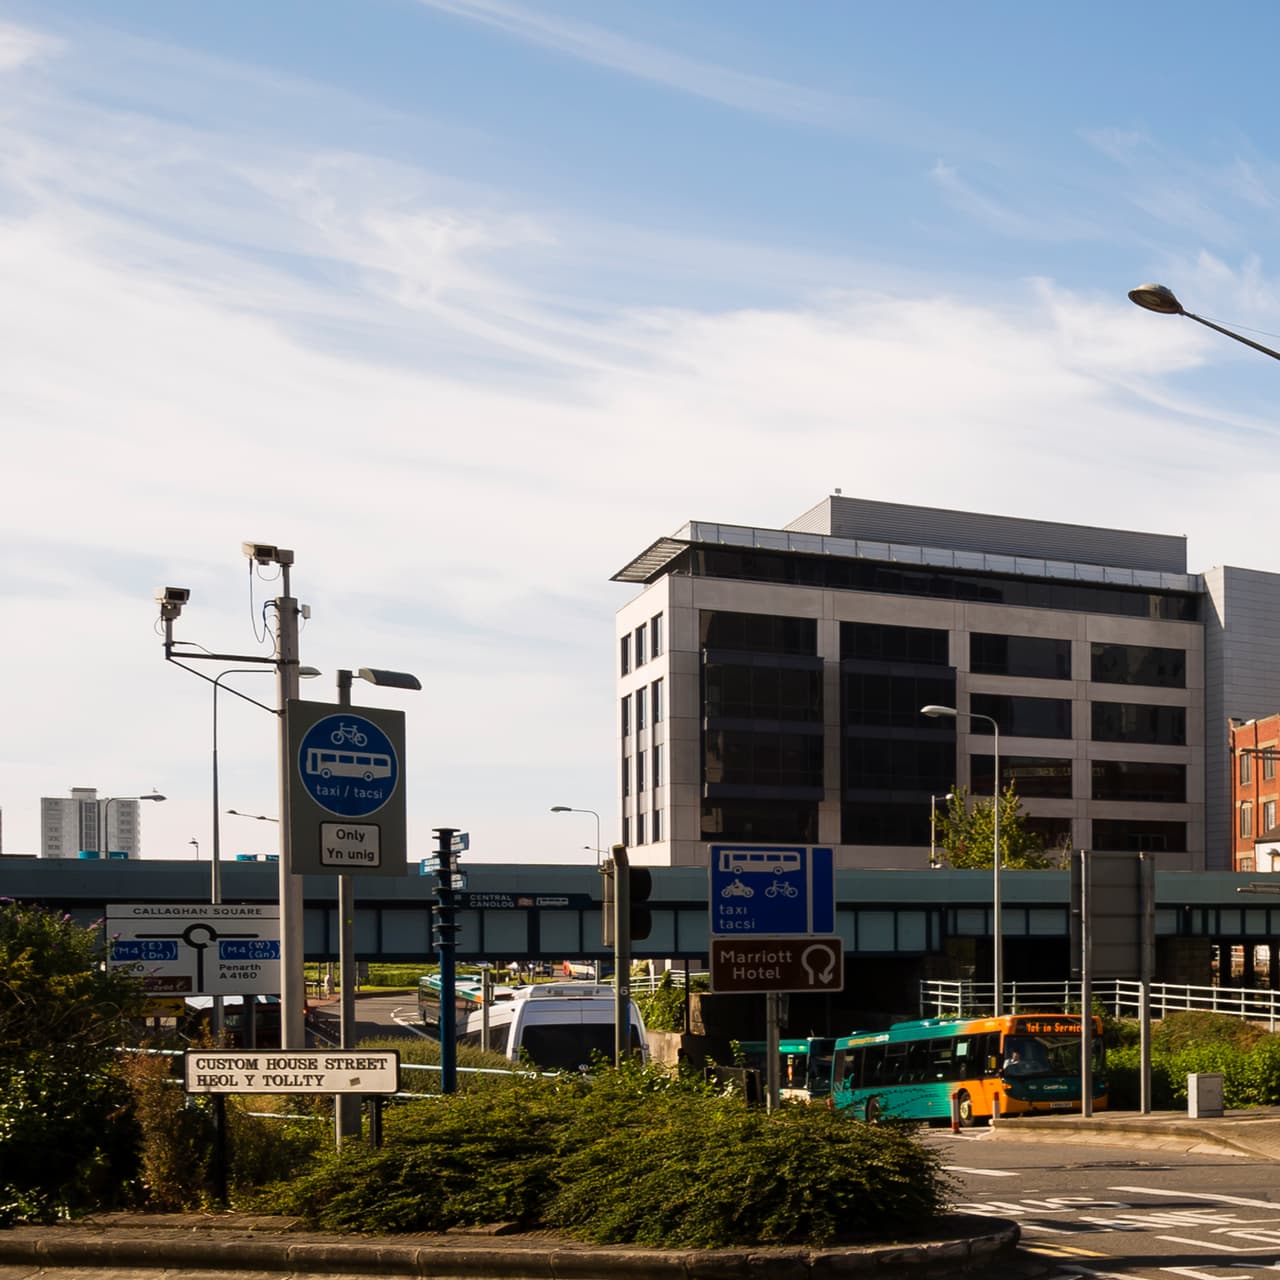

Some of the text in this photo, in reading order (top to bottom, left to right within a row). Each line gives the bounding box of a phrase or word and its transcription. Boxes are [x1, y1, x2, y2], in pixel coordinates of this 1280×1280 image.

[316, 784, 340, 797] taxi
[354, 788, 383, 799] tacsi
[336, 828, 365, 842] Only
[327, 848, 375, 861] Yn unig
[213, 908, 262, 916] SQUARE
[719, 904, 747, 915] taxi
[720, 918, 755, 929] tacsi
[720, 951, 792, 963] Marriott
[733, 967, 780, 979] Hotel
[196, 1058, 387, 1070] CUSTOM HOUSE STREET
[197, 1074, 325, 1086] HEOL Y TOLLTY
[946, 1197, 1131, 1216] BUS
